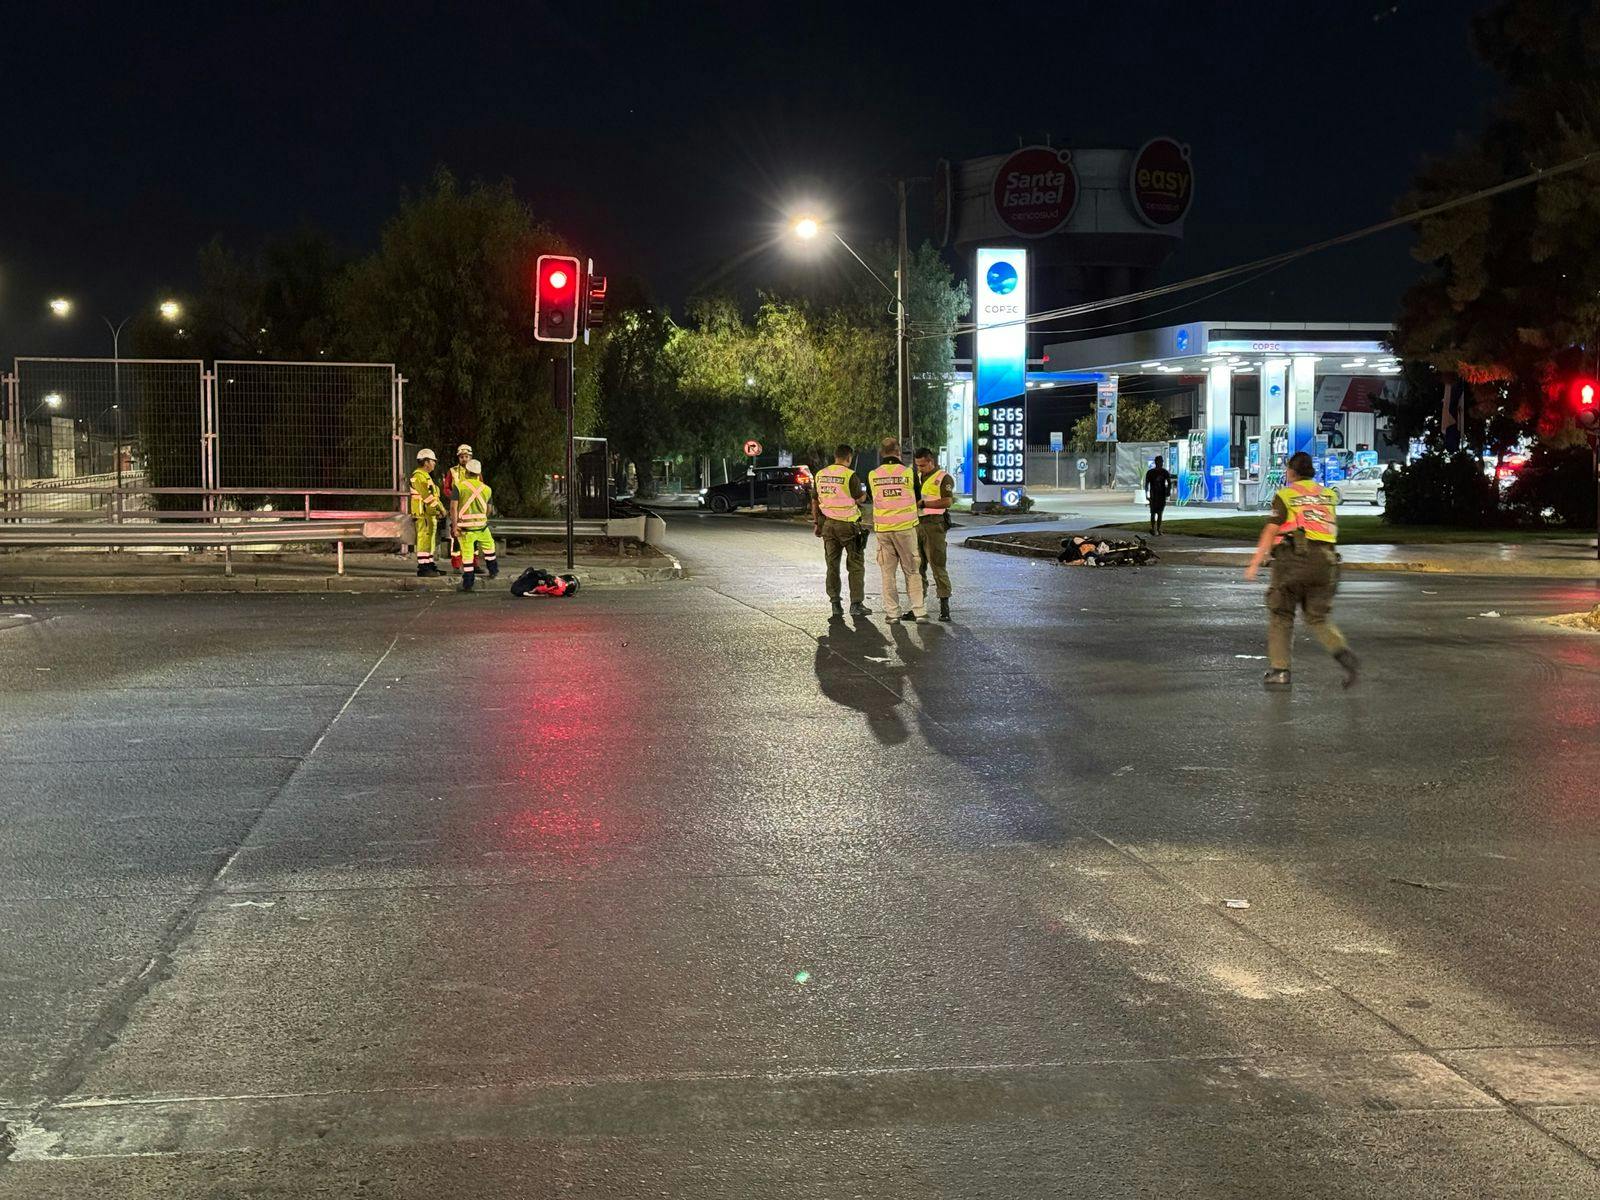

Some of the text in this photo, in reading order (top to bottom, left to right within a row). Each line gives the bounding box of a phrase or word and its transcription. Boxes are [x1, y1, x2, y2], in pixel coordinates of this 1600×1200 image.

[1006, 170, 1066, 188] Santa
[1137, 167, 1189, 198] easy
[1003, 185, 1064, 207] Isabel
[984, 305, 1019, 314] COPEC
[1252, 343, 1281, 351] COPEC
